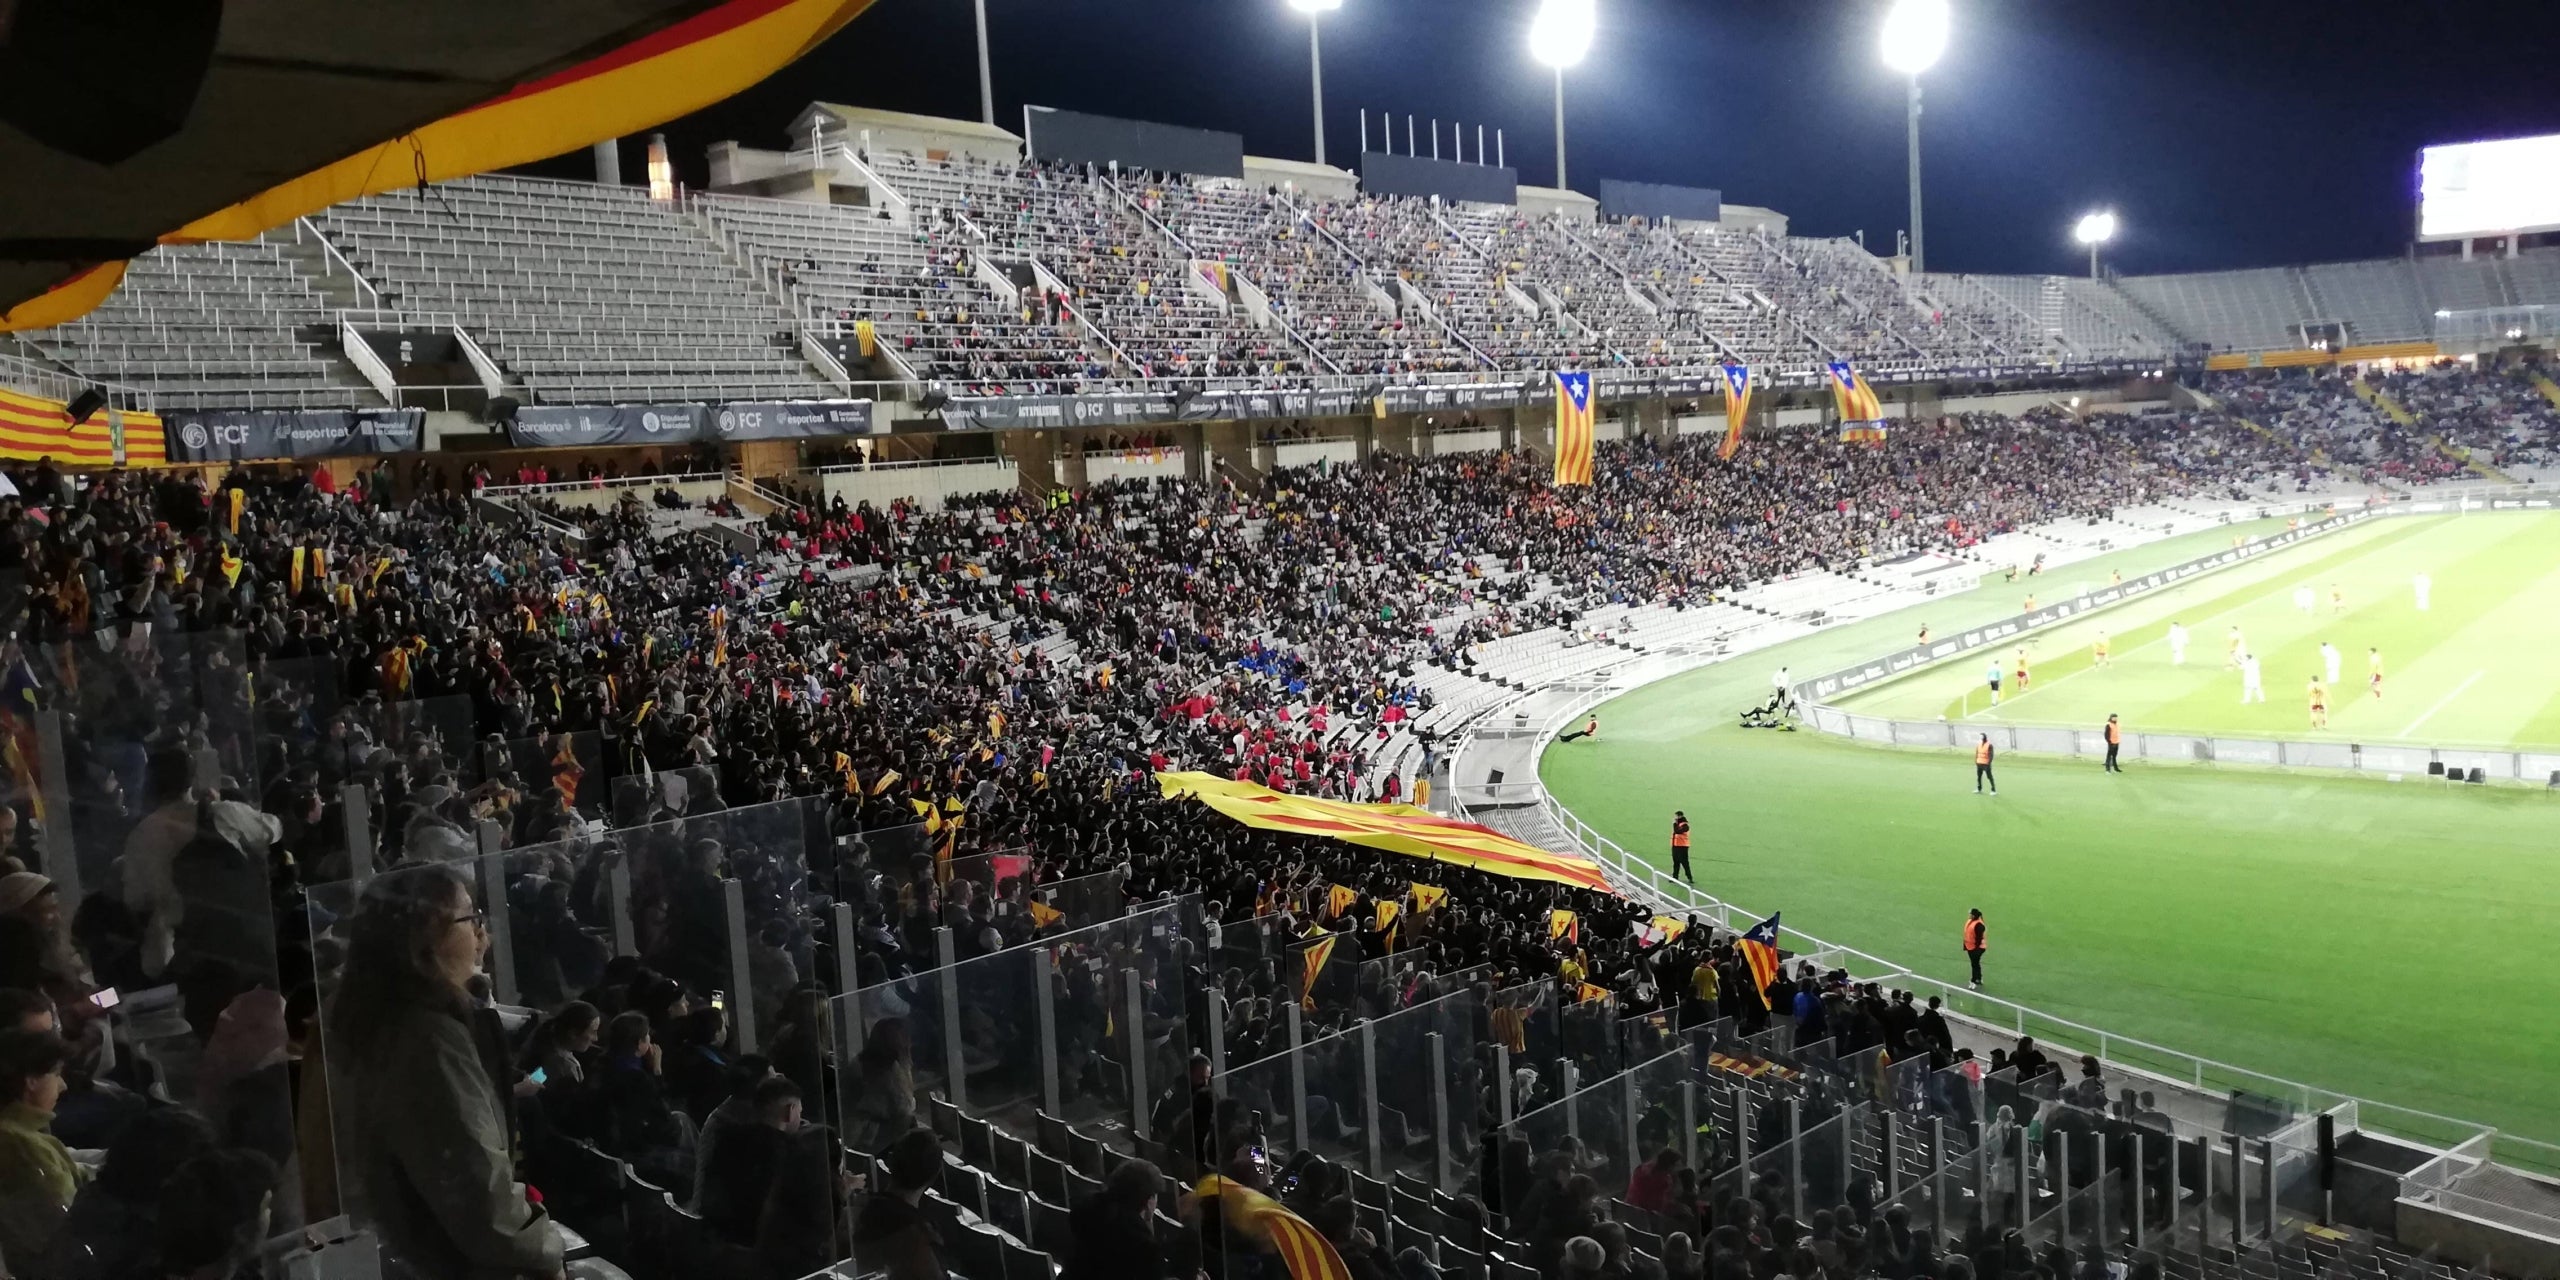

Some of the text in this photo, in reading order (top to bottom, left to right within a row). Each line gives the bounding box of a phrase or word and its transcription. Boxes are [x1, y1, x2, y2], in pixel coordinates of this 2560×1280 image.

[1087, 402, 1104, 417] FCF
[738, 412, 763, 428] FCF
[787, 414, 825, 425] esportcat
[291, 427, 349, 440] esportcat
[518, 421, 564, 433] Barcelona
[213, 424, 250, 445] FCF
